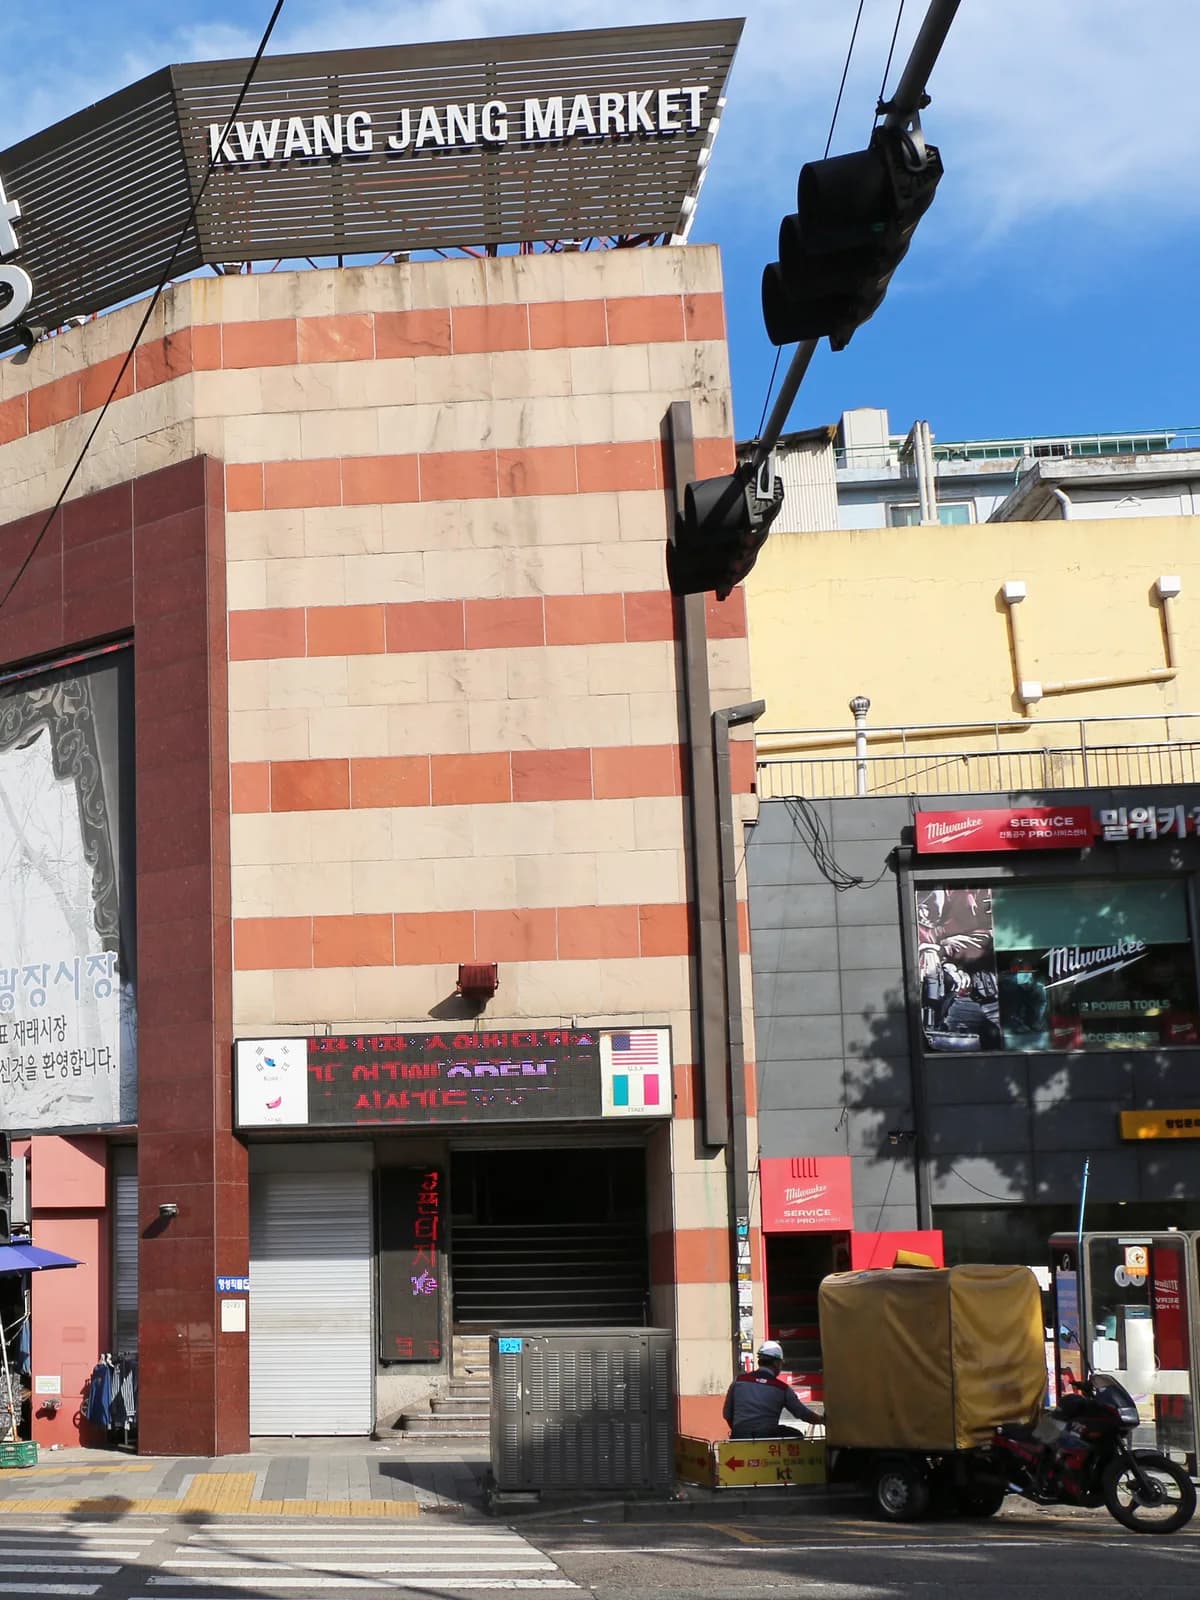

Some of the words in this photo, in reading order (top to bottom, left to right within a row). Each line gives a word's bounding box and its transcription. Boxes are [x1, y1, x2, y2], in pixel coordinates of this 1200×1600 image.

[209, 111, 374, 164] KWANG
[388, 100, 508, 150] JANG
[523, 86, 709, 140] MARKET
[924, 817, 984, 839] Milwaukee
[1010, 815, 1074, 828] SERVICE
[1099, 804, 1187, 842] 밀워키
[1040, 937, 1149, 979] Milwaukee
[1091, 1000, 1131, 1011] POWER
[1134, 999, 1171, 1009] TOOLS
[13, 1014, 67, 1047] 재래시장
[43, 1045, 116, 1081] 환영합니다.
[784, 1184, 828, 1201] Milwaukee
[783, 1208, 832, 1217] SERVICE
[776, 1467, 793, 1480] kt
